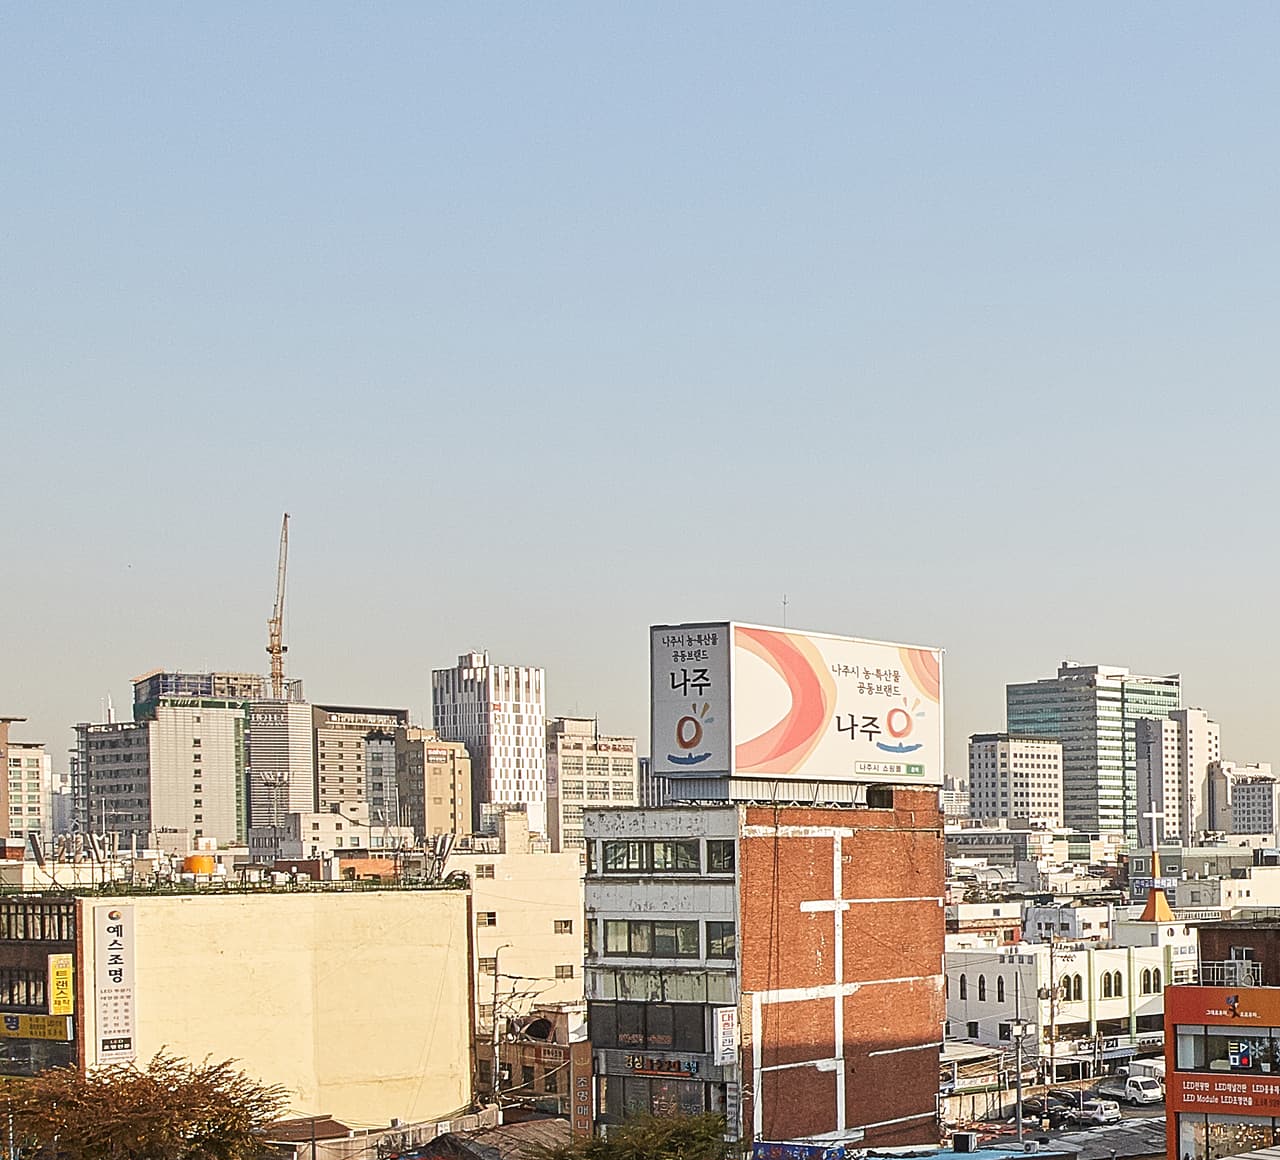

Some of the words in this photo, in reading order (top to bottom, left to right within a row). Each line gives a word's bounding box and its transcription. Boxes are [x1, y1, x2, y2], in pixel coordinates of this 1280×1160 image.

[662, 635, 684, 646] 나주시
[671, 650, 709, 663] 공동브랜드
[831, 664, 859, 678] 나주시
[670, 668, 712, 697] 나주
[857, 682, 902, 697] 공동브랜드
[835, 713, 882, 741] 나주
[106, 924, 124, 984] 예스조명
[56, 970, 69, 999] 트랜스
[1183, 1094, 1195, 1102] LED
